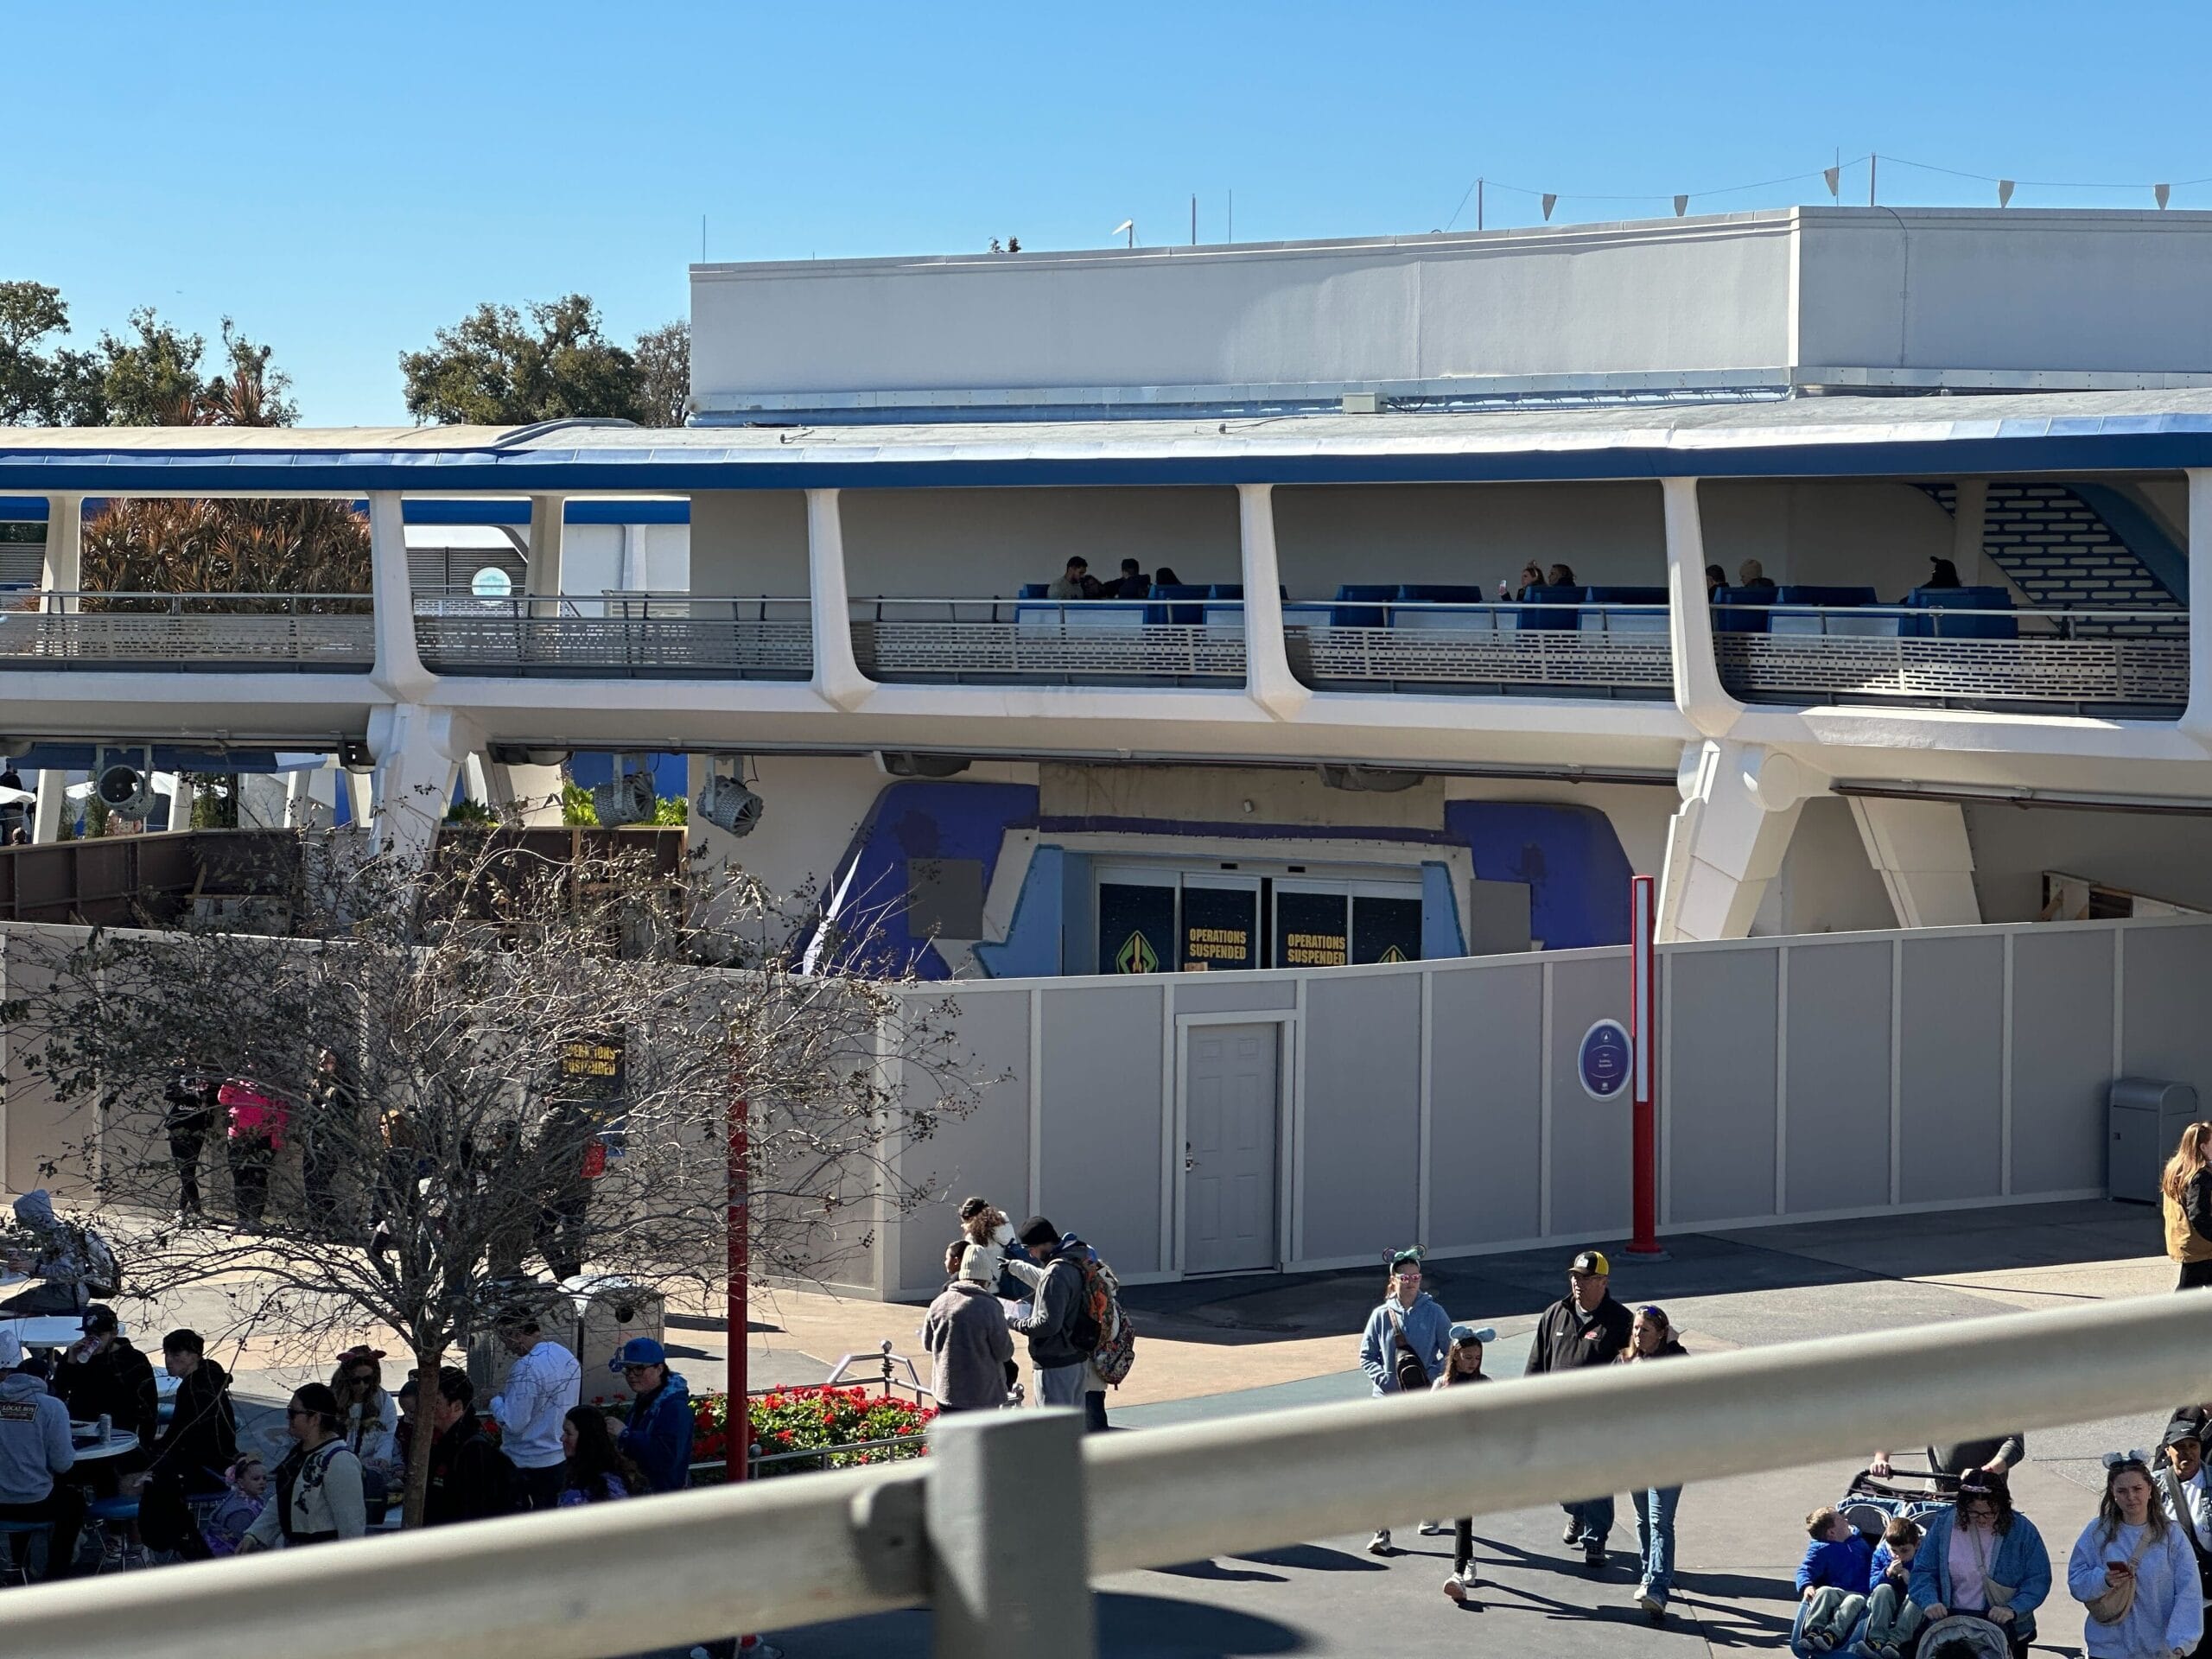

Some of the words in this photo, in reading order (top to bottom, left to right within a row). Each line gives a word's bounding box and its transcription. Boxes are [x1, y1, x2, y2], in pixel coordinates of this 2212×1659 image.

[1189, 928, 1247, 944] OPERATIONS
[1287, 934, 1345, 950] OPERATIONS
[1189, 944, 1247, 960] SUSPENDED
[1287, 950, 1345, 965] SUSPENDED
[562, 1043, 616, 1060] PERAIONS
